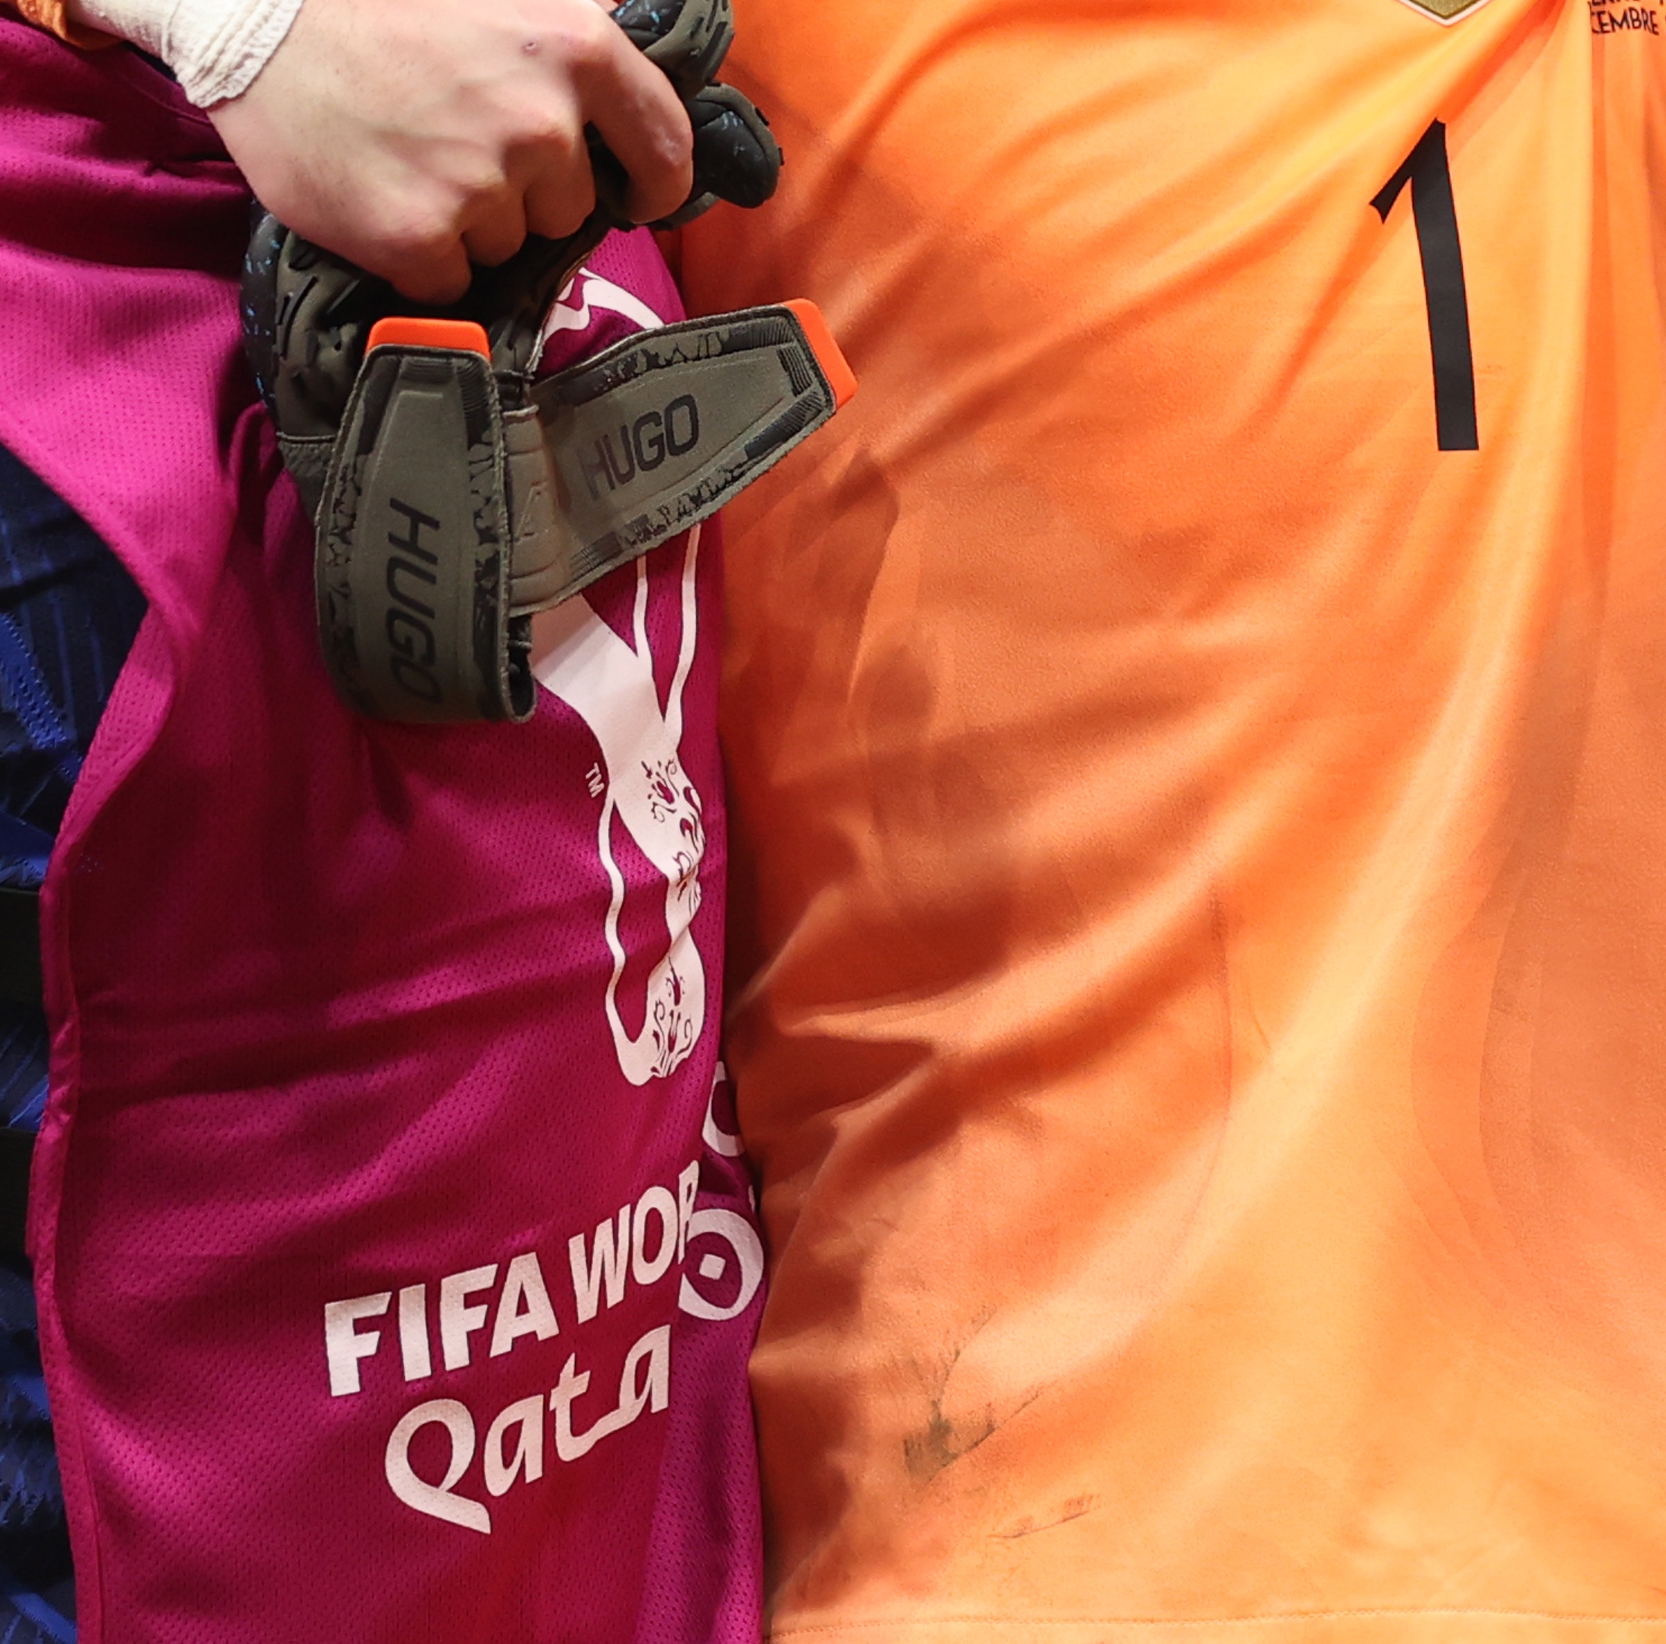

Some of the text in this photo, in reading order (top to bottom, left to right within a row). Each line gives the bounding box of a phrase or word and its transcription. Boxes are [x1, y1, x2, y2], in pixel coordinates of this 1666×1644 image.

[1369, 116, 1479, 451] 1
[575, 393, 700, 500] HUGO
[385, 496, 444, 704] HUGO
[324, 1251, 560, 1398] FIFA
